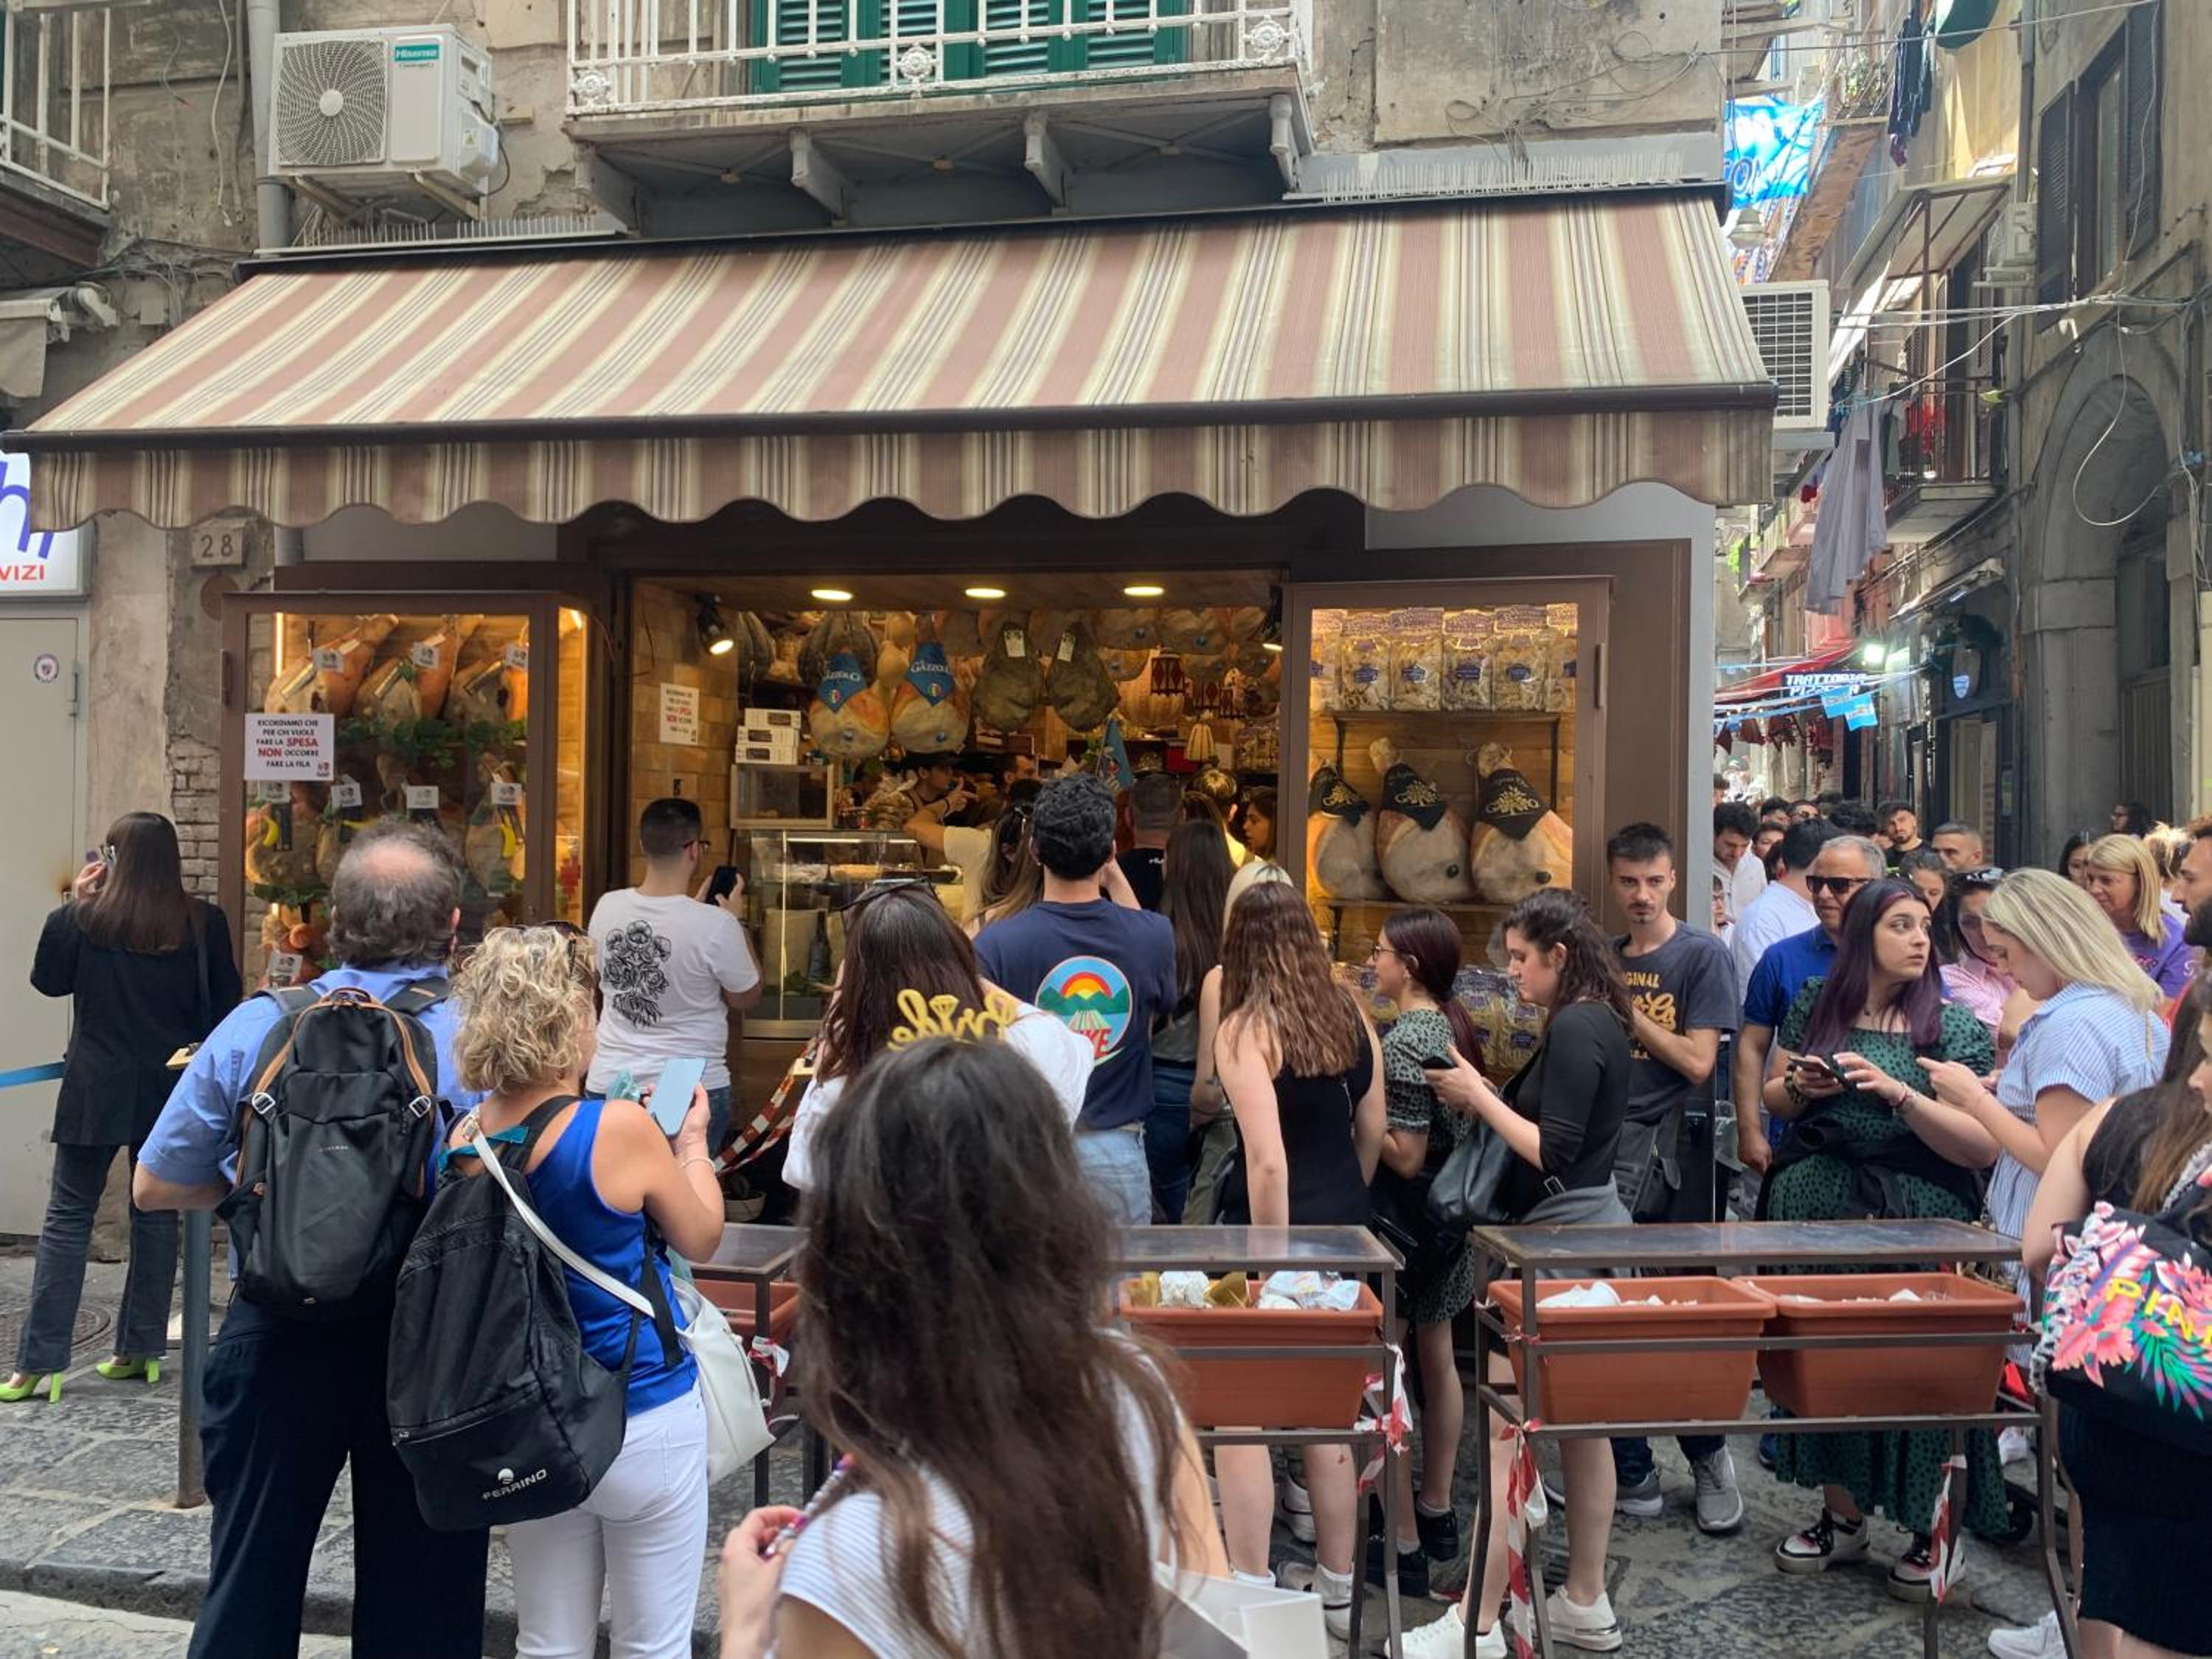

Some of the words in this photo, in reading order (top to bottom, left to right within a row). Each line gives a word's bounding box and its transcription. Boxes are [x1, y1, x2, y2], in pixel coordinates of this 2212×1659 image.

[201, 533, 233, 558] 28
[1786, 672, 1866, 685] TRATTORIA
[286, 737, 319, 746] SPESA
[258, 748, 282, 757] NON
[1627, 971, 1660, 988] GINAL
[2106, 1277, 2212, 1345] PIN
[482, 1469, 546, 1500] FERRINO
